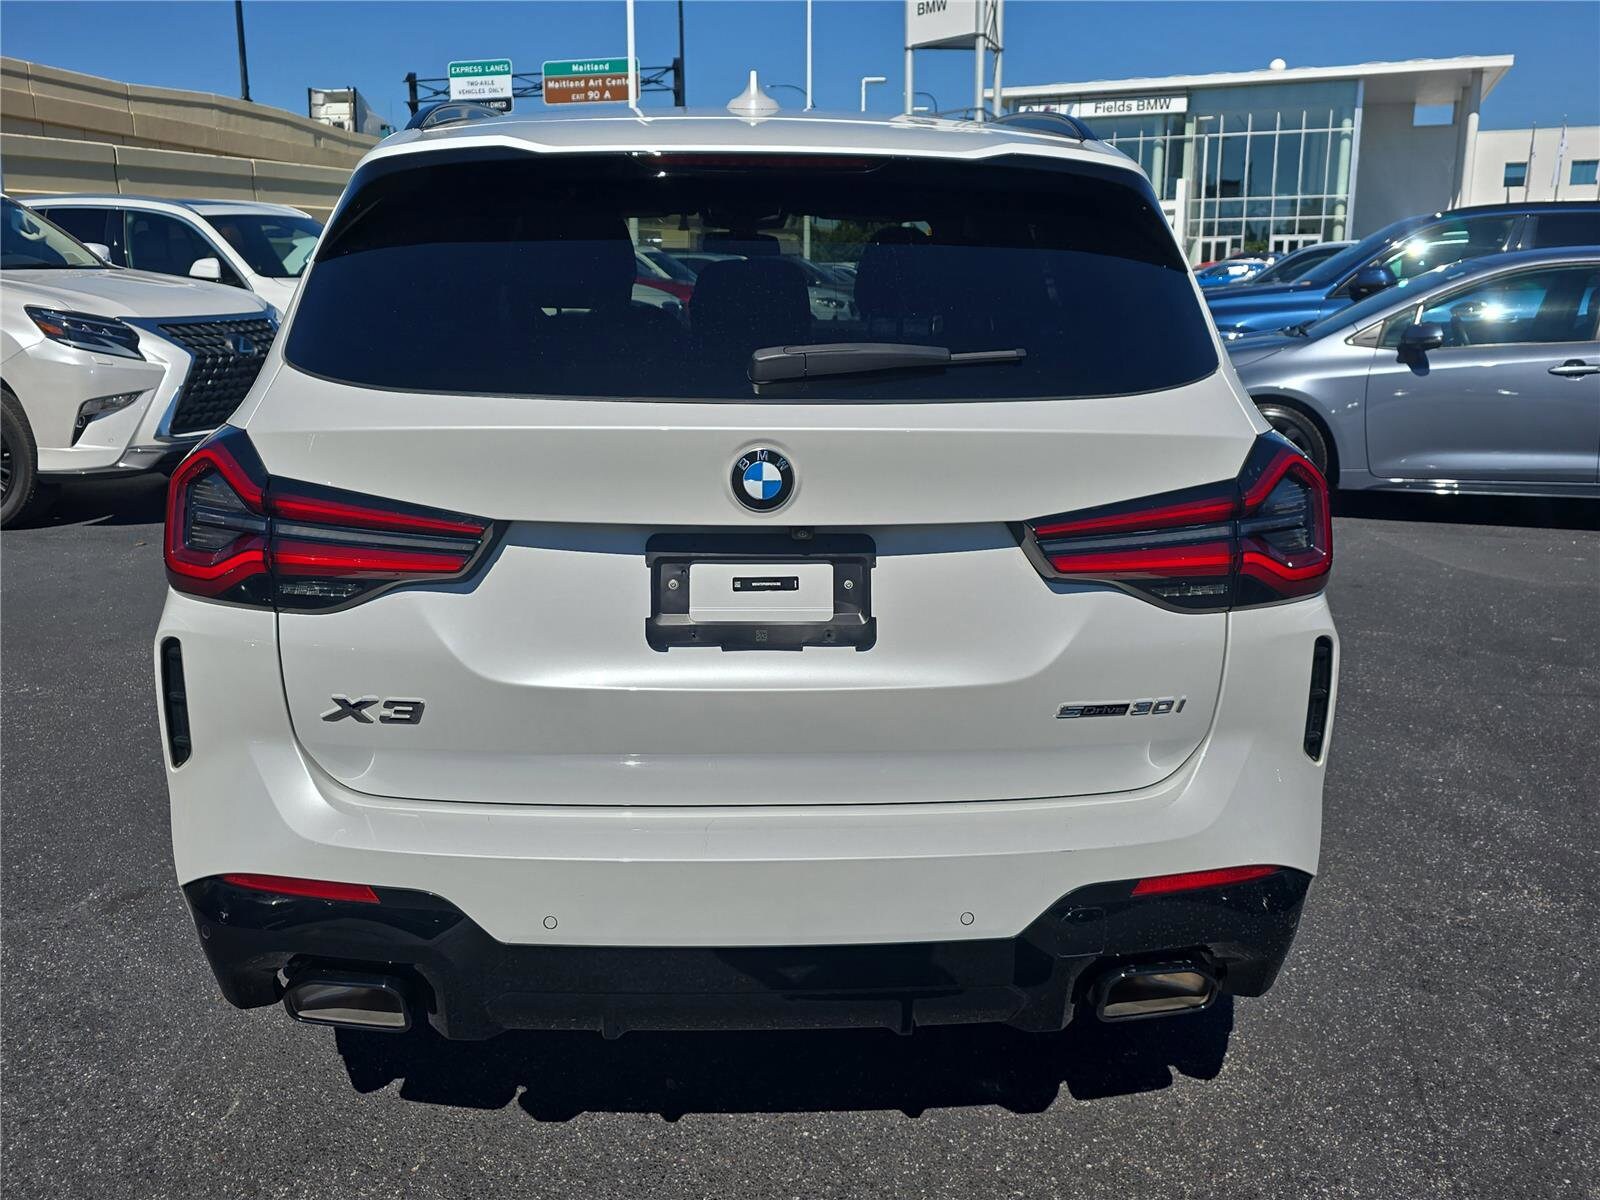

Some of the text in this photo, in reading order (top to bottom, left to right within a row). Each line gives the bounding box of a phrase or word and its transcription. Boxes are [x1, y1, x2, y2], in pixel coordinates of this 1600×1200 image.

[917, 0, 947, 15] BMW
[451, 63, 509, 74] EXPRESS LANES
[571, 62, 610, 72] Maitland
[547, 79, 585, 89] Maitland
[588, 78, 602, 87] Art
[458, 86, 504, 95] VEHICLES ONLY
[571, 89, 612, 101] EXIT 90 A
[1094, 98, 1171, 114] Fields BMW
[737, 450, 789, 471] BMW
[320, 694, 425, 725] X3
